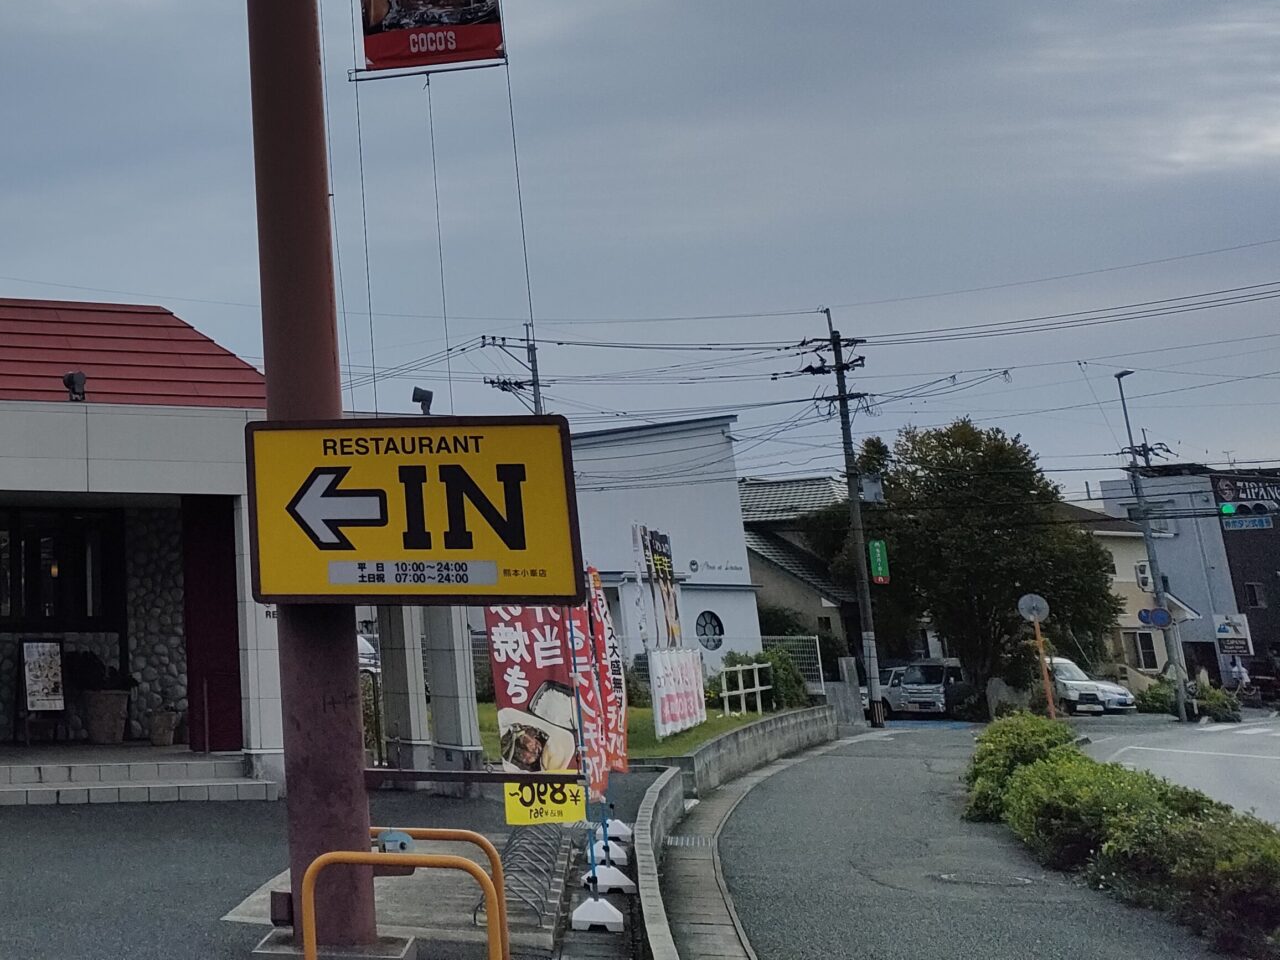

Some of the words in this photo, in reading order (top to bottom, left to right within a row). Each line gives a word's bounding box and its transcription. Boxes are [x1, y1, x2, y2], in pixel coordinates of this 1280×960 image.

[409, 32, 456, 53] COCO'S
[323, 436, 484, 456] RESTAURANT
[398, 464, 527, 550] IN
[357, 573, 386, 584] 土日祝
